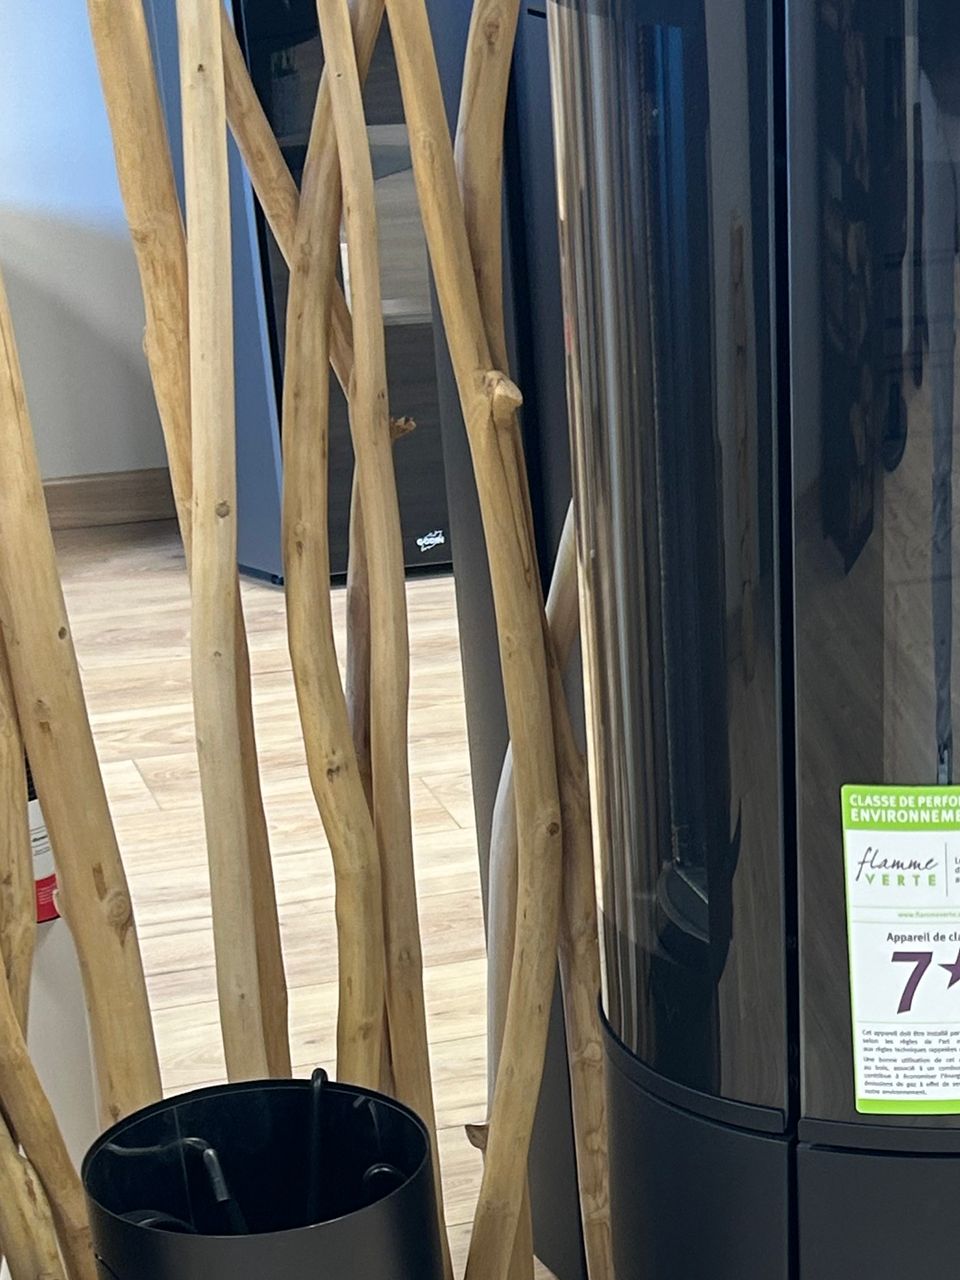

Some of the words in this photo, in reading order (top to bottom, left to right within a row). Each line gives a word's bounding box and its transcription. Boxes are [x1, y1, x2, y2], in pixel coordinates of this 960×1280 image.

[850, 794, 896, 807] CLASSE
[900, 796, 915, 807] DE
[856, 847, 938, 881] flamme
[865, 874, 936, 886] VERTE
[887, 932, 930, 943] Appareil
[933, 933, 945, 941] de
[891, 951, 933, 1015] 7
